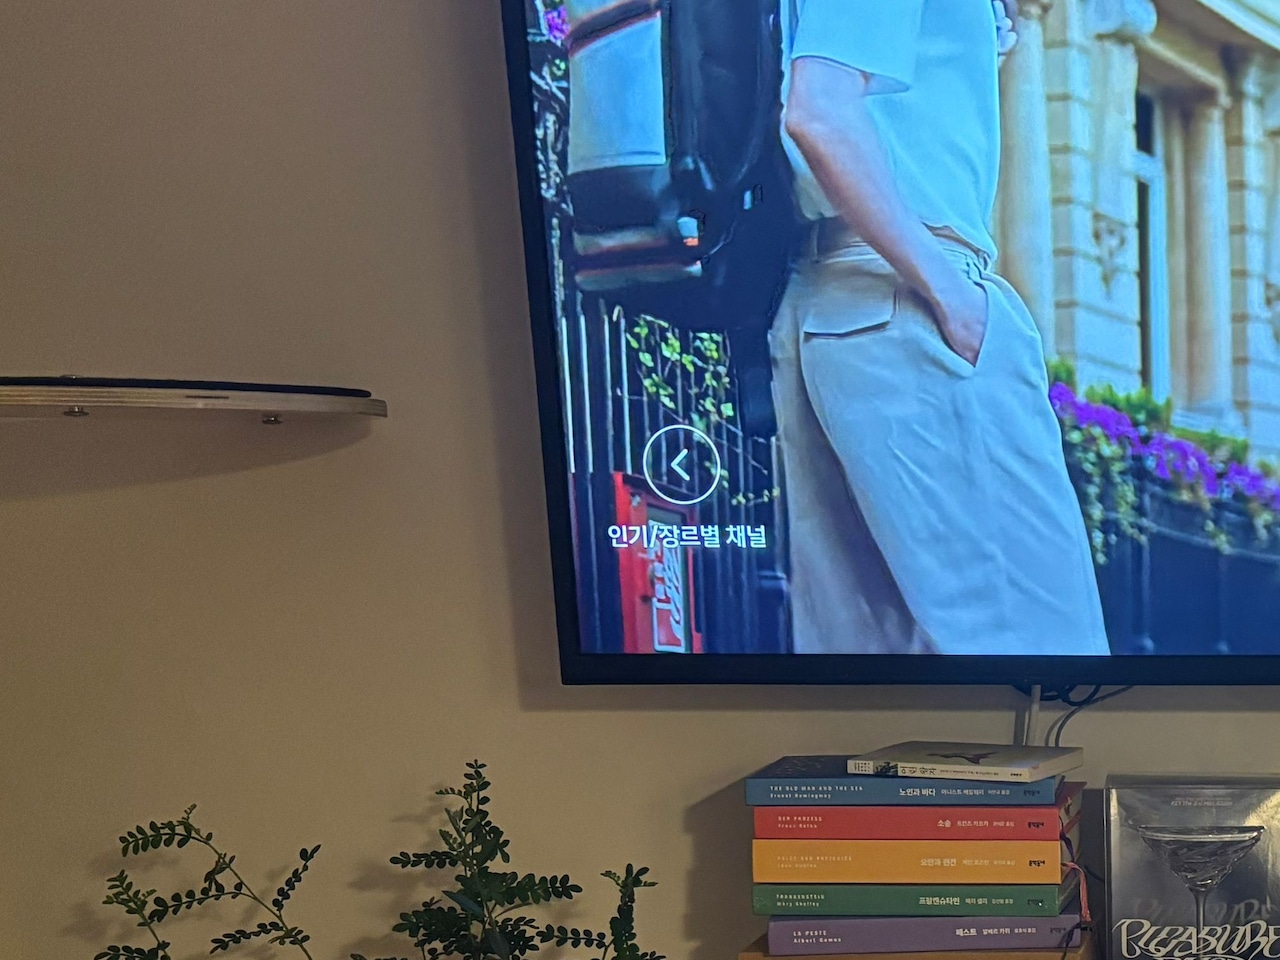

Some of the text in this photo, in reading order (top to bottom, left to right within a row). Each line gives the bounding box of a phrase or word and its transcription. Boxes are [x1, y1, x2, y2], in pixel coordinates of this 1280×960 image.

[607, 524, 767, 549] 인기/장르별 채널
[898, 788, 920, 797] 노인과
[921, 788, 936, 797] 바다
[937, 819, 952, 828] 소송
[918, 896, 961, 906] 프랑켄슈타인
[955, 928, 977, 937] 페스트
